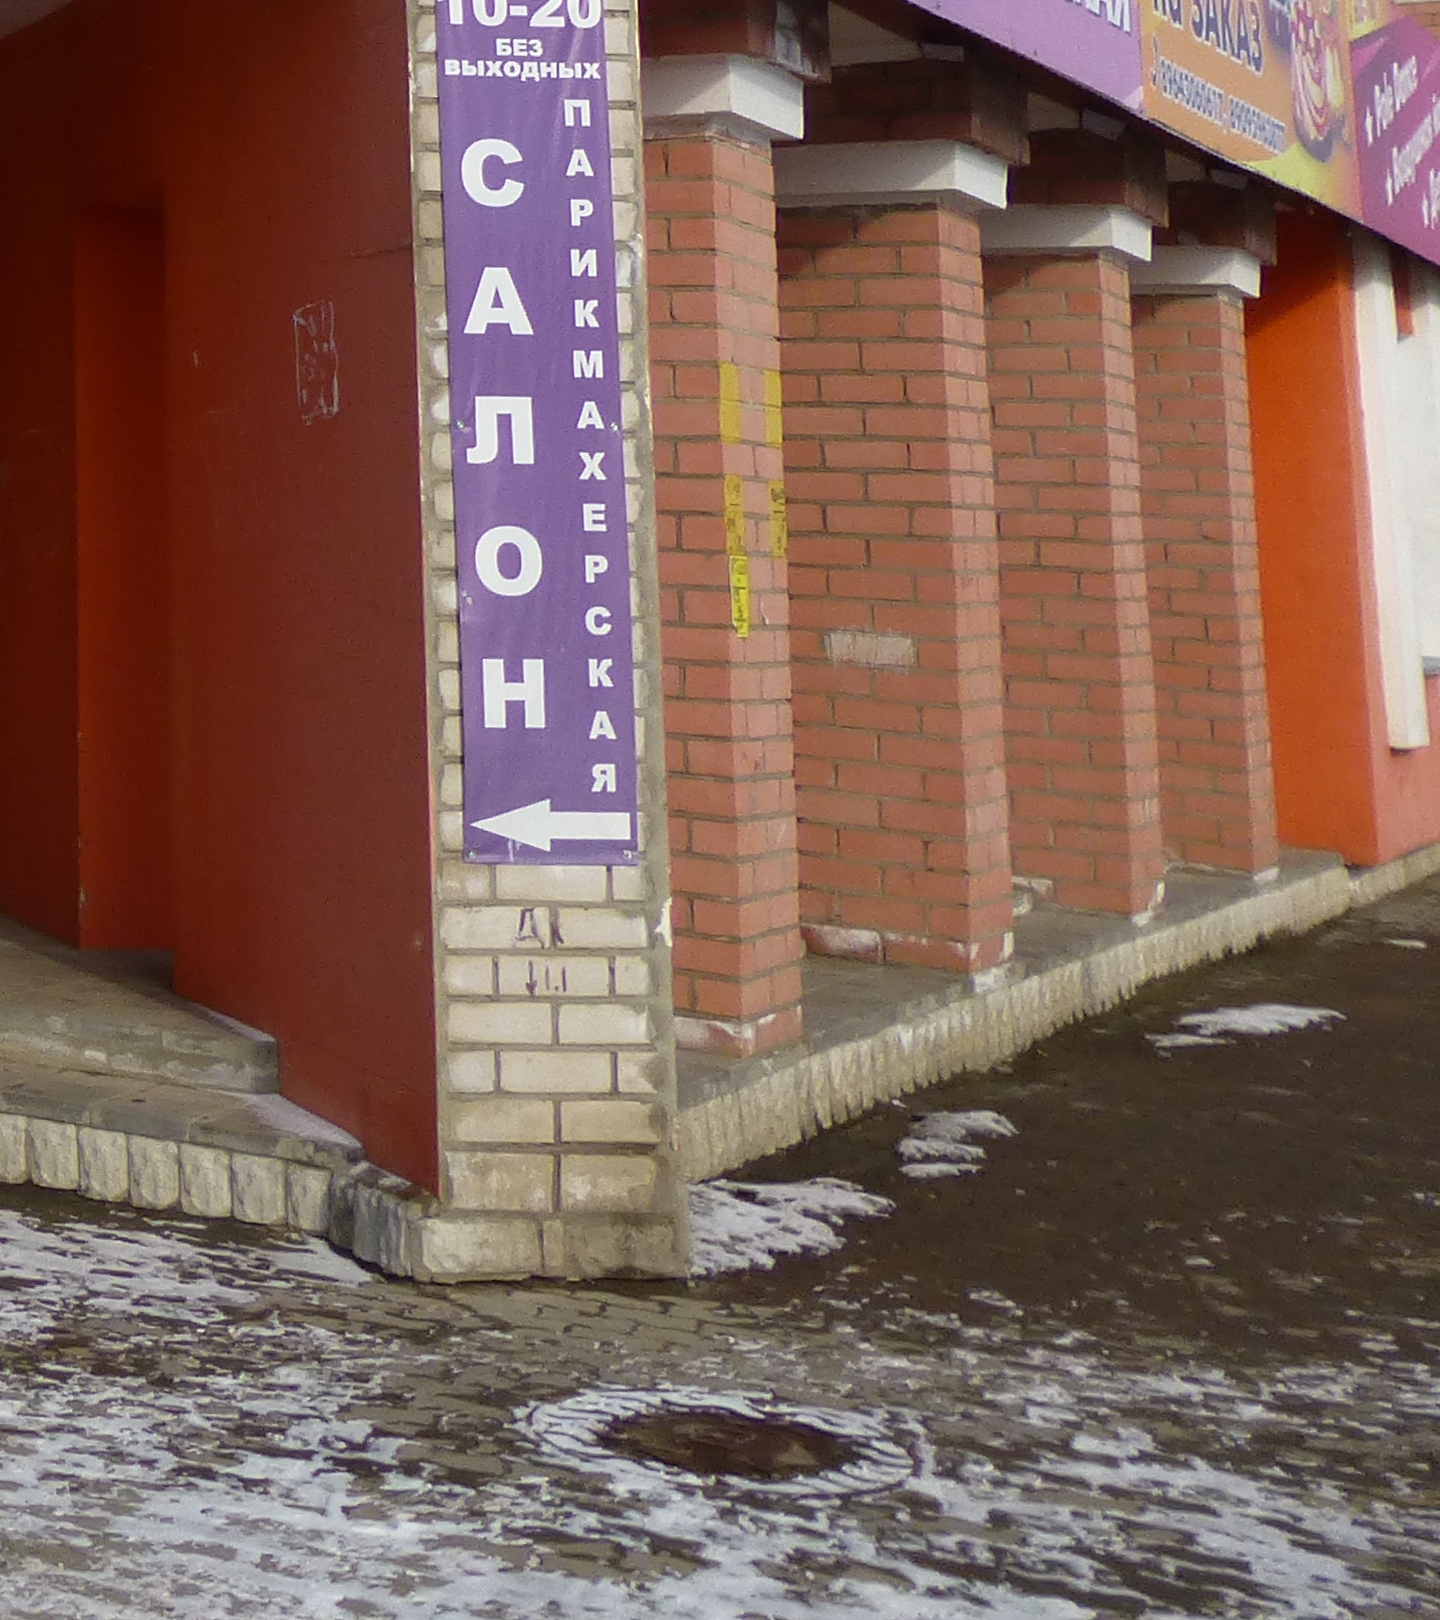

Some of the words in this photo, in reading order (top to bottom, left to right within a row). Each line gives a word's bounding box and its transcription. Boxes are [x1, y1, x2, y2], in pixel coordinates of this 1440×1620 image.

[495, 38, 543, 57] БЕЗ
[443, 59, 601, 82] ВЫХОДНЫХ
[461, 138, 547, 729] САЛОН
